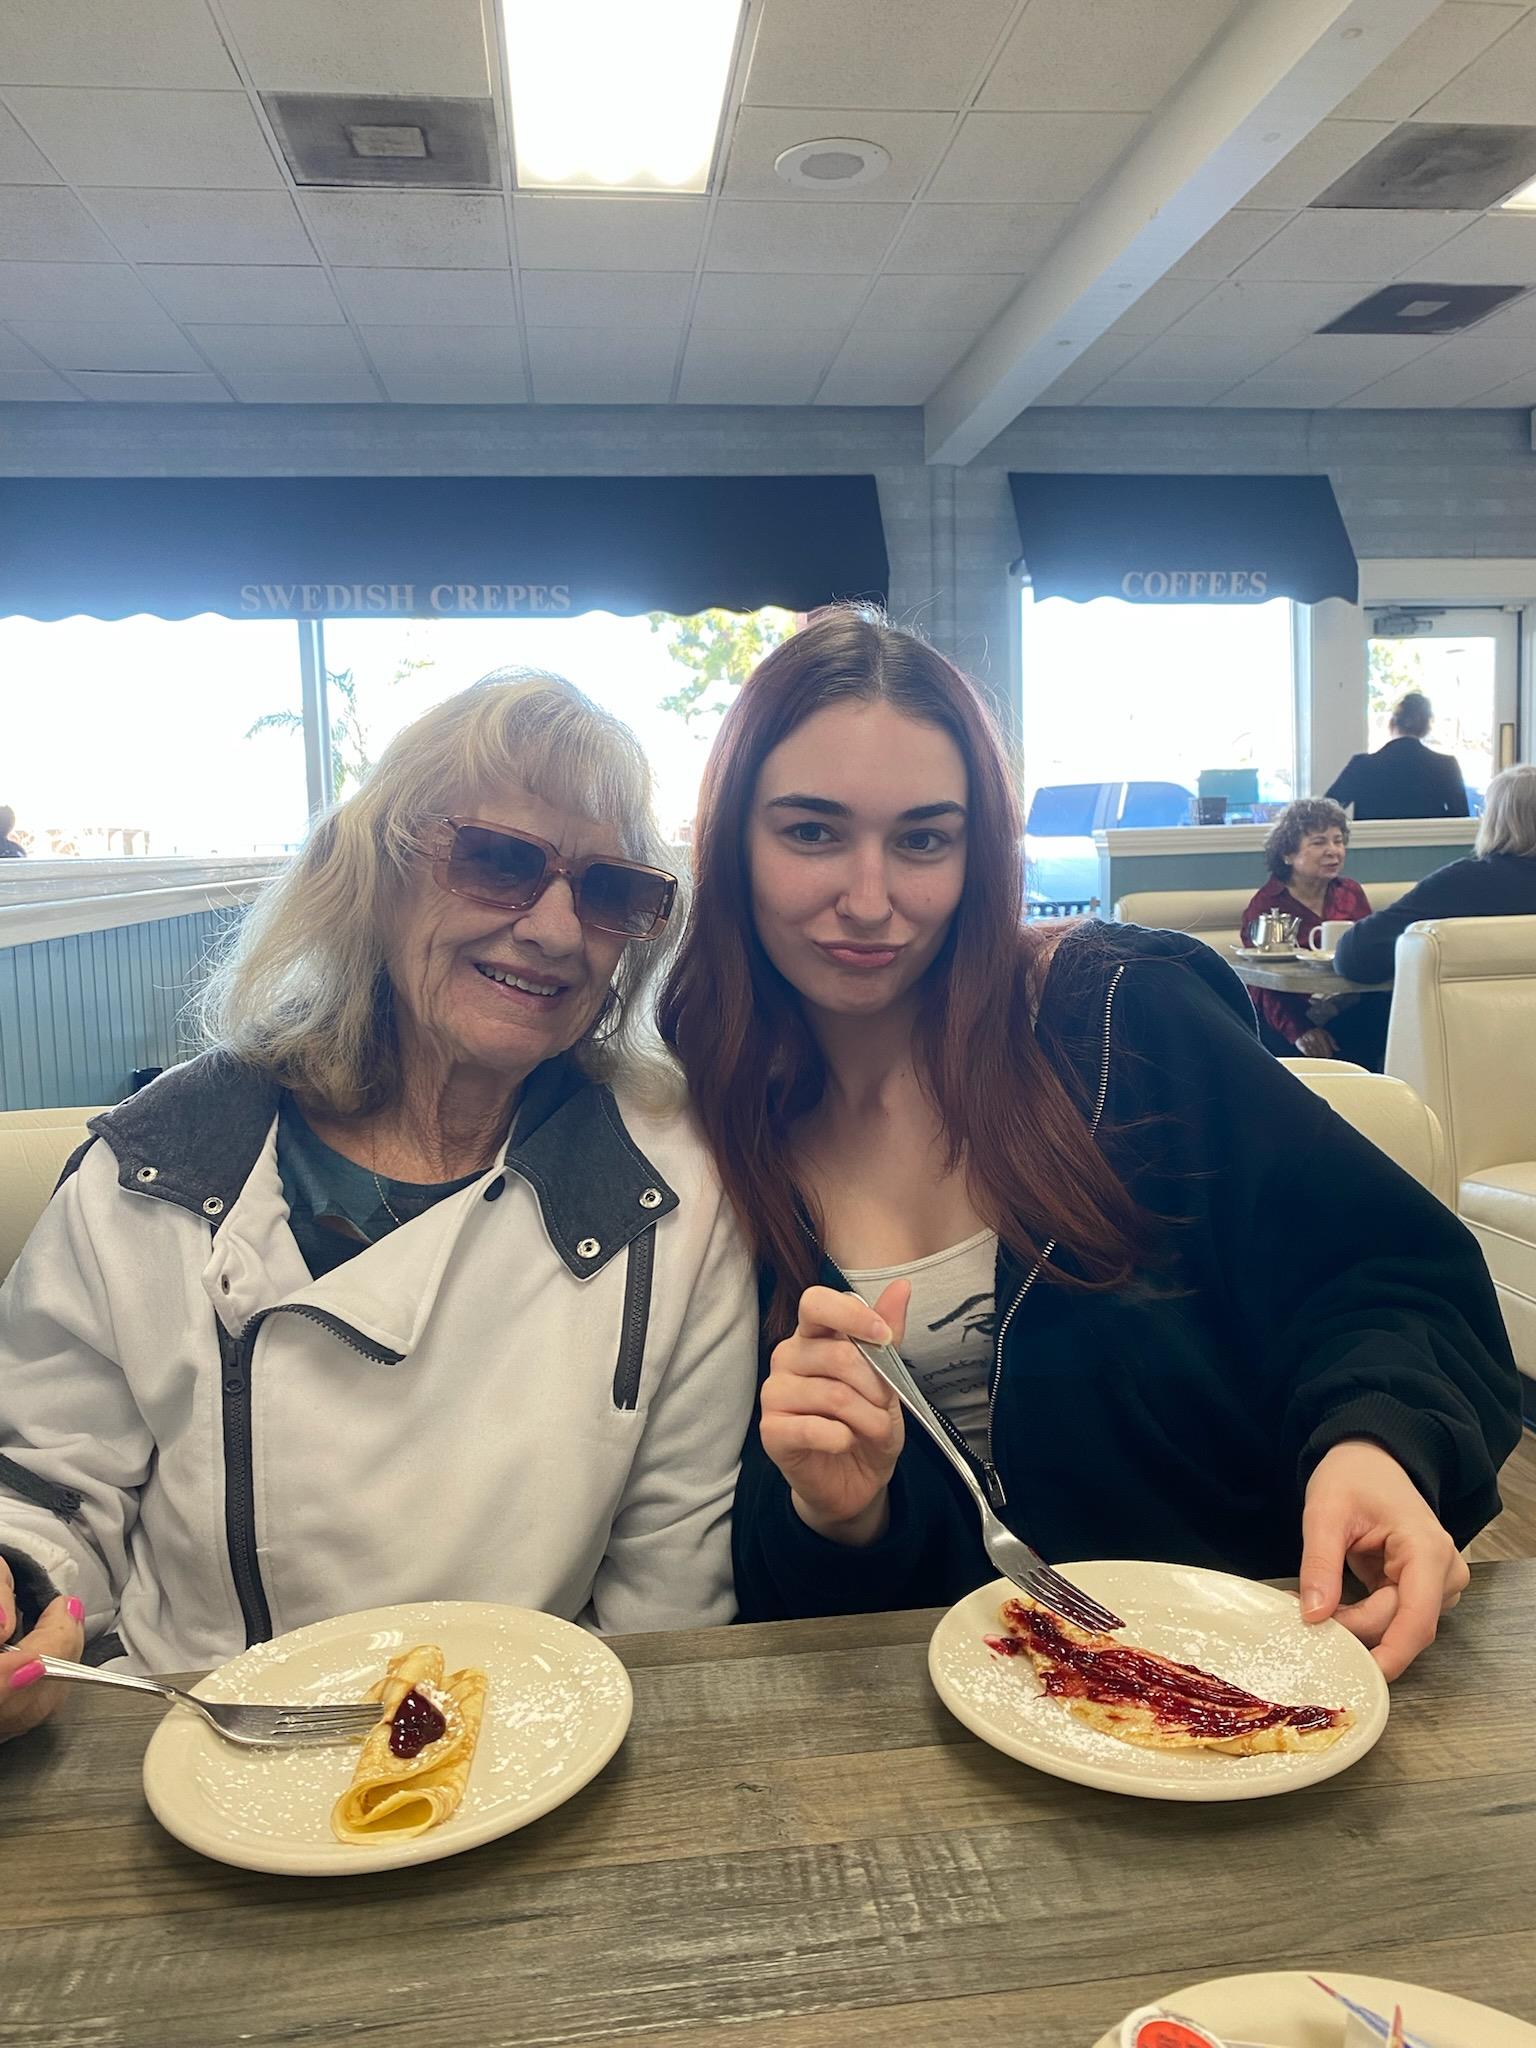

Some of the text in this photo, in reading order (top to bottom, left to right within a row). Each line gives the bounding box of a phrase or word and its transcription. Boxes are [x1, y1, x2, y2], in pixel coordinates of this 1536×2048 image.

[1121, 570, 1268, 597] COFFEES
[240, 584, 571, 612] SWEDISH CREPES
